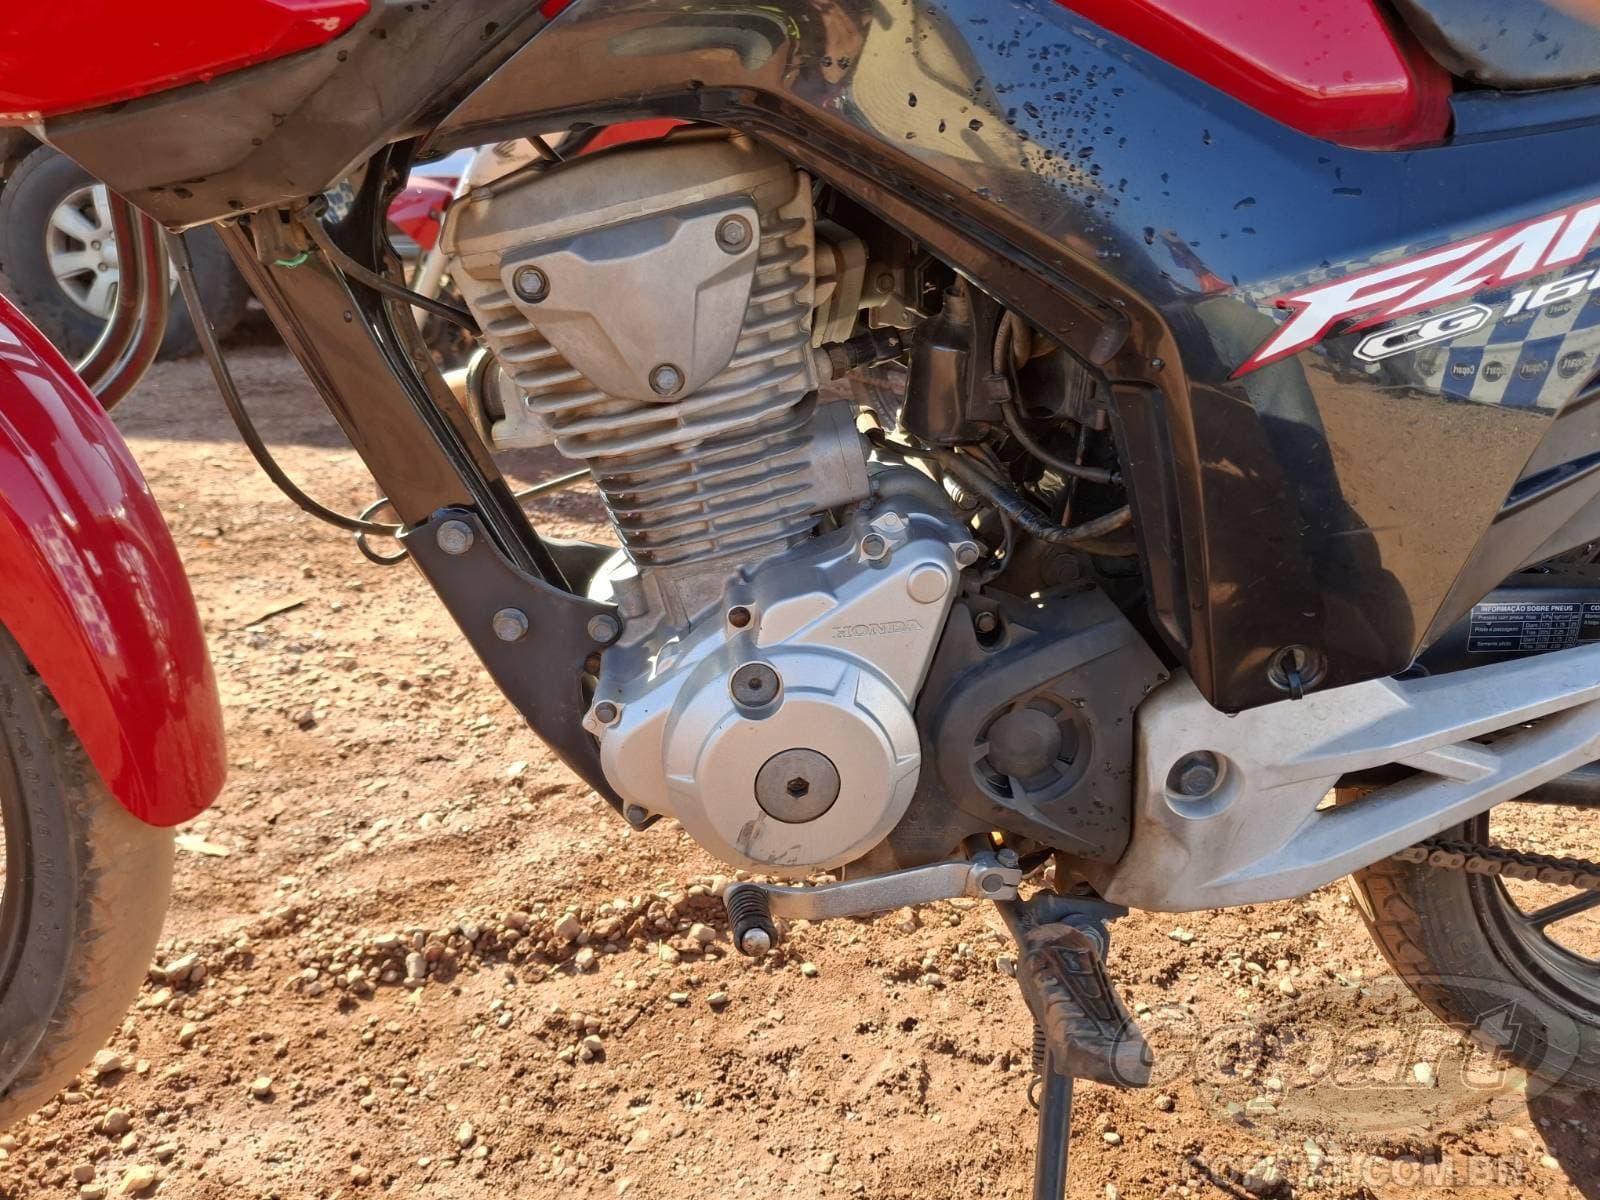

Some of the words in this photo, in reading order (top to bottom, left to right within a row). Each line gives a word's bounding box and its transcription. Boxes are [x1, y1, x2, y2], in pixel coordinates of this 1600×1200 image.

[1356, 306, 1490, 359] CG
[1502, 266, 1600, 318] 16
[831, 619, 924, 639] HONDA
